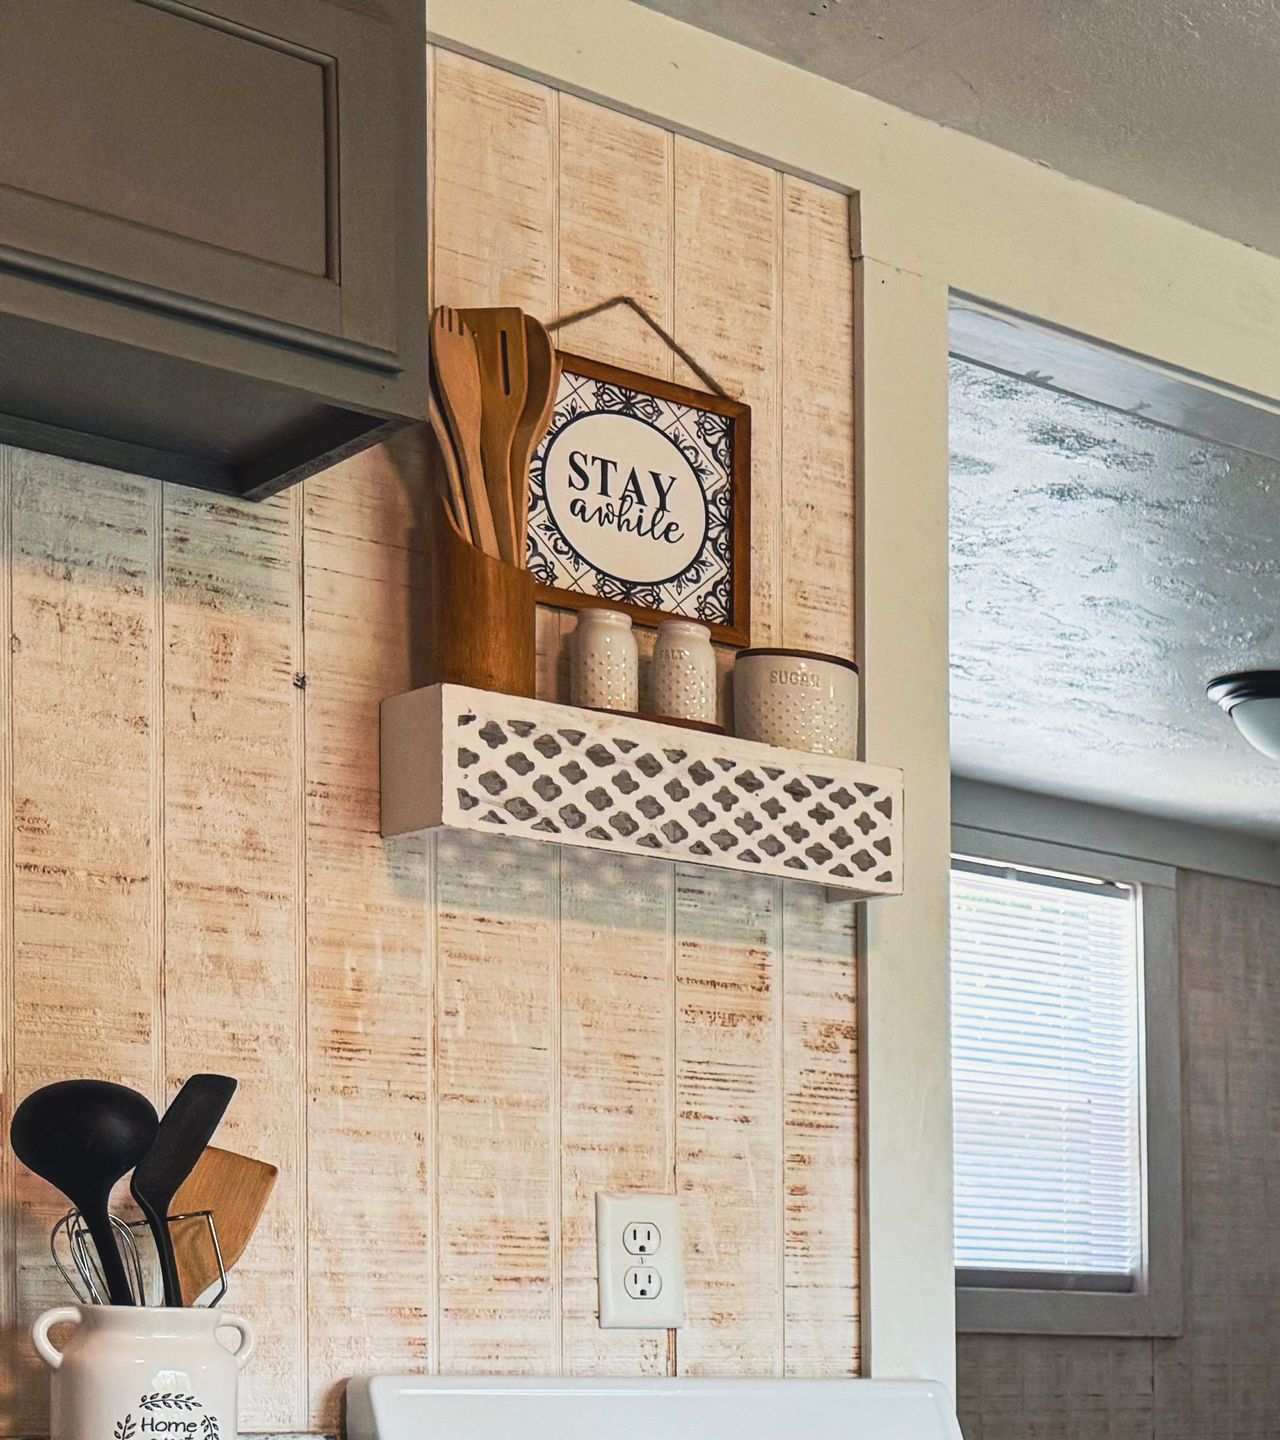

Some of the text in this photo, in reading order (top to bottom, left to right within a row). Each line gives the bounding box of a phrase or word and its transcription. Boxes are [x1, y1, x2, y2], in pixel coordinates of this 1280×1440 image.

[568, 451, 678, 513] STAY
[570, 494, 685, 543] awhile
[769, 669, 821, 690] SUGAR
[141, 1417, 198, 1433] Home
